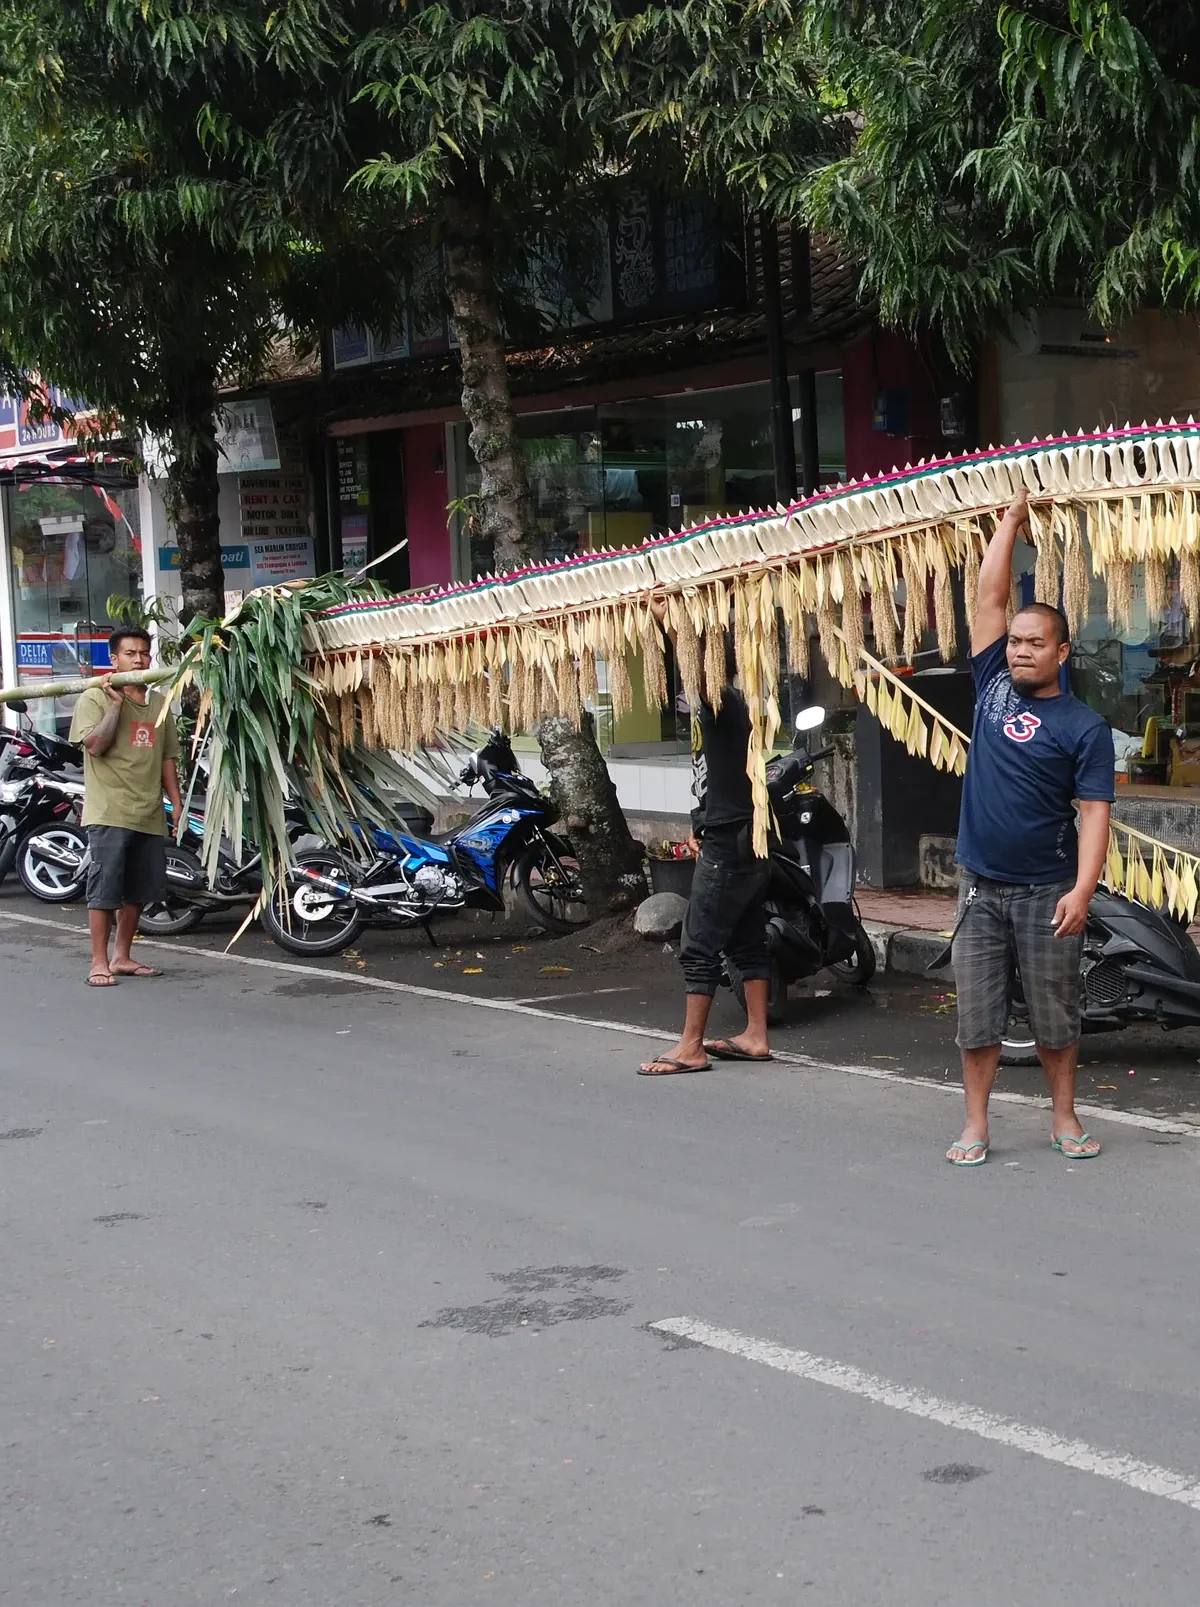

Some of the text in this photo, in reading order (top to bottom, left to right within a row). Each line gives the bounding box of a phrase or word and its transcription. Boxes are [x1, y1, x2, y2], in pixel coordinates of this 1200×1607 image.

[244, 494, 301, 505] RENT A CAR
[247, 510, 300, 520] MOTOR BIKE
[20, 644, 48, 657] DELTA
